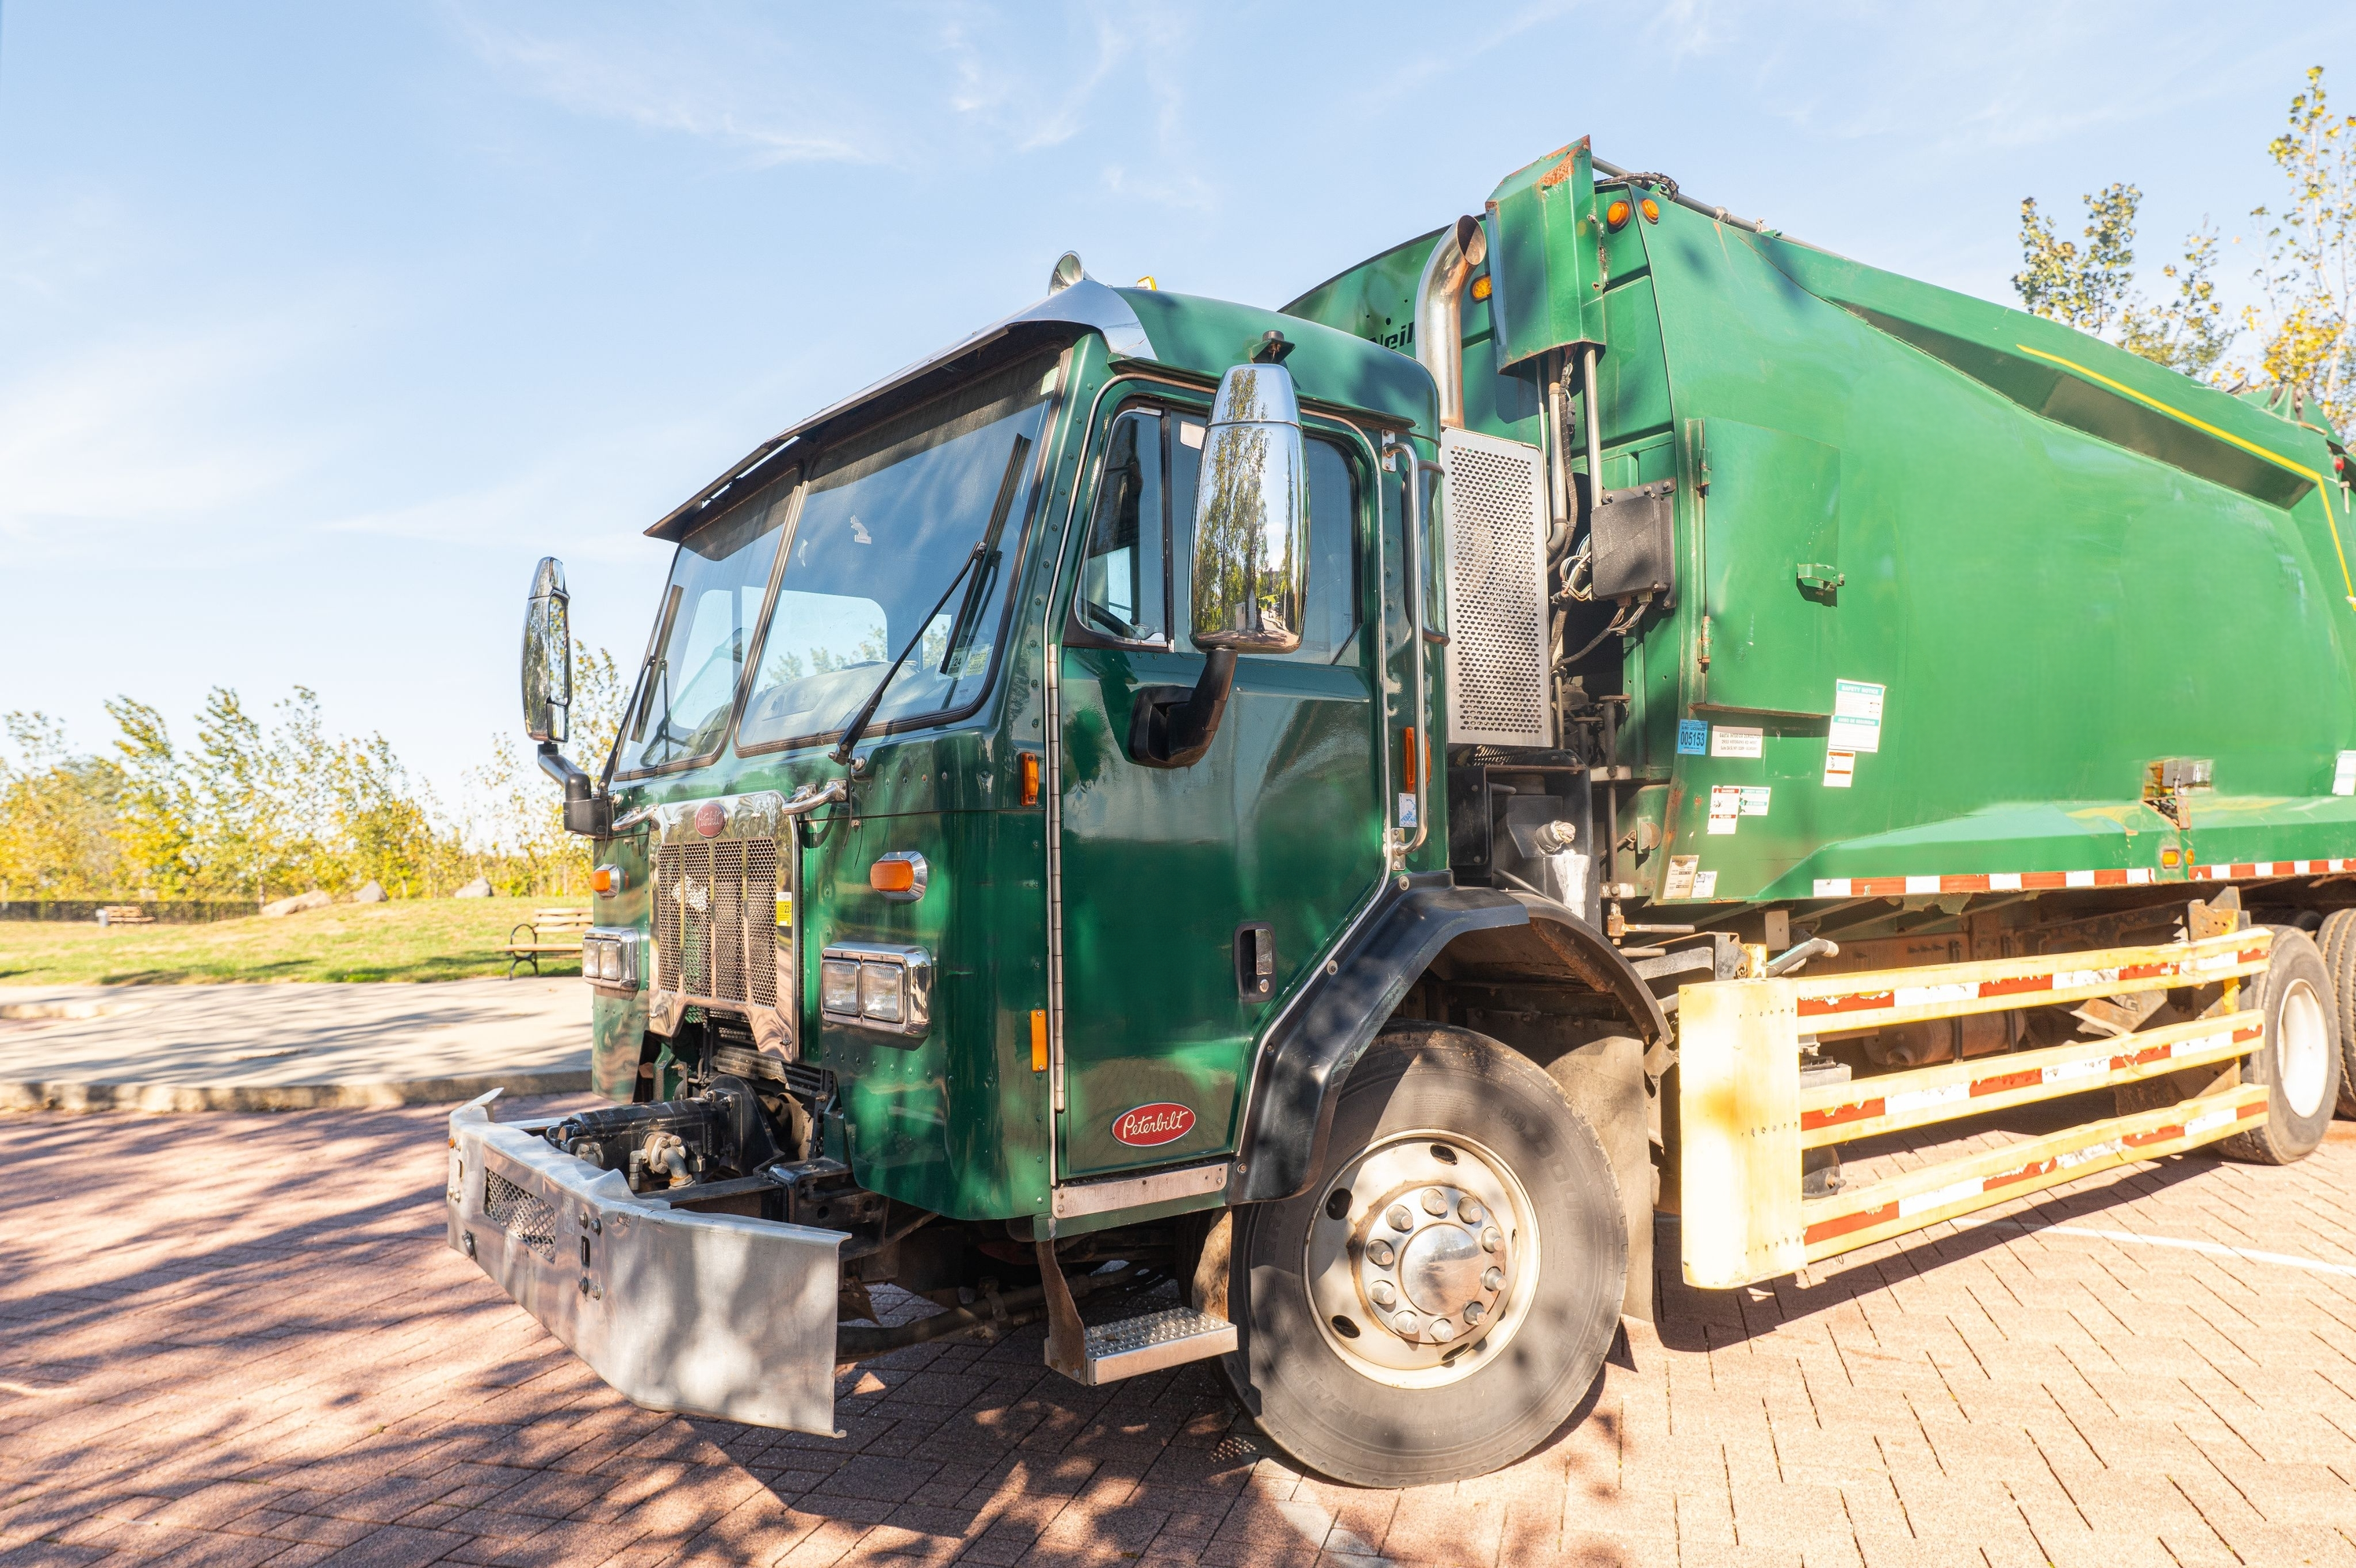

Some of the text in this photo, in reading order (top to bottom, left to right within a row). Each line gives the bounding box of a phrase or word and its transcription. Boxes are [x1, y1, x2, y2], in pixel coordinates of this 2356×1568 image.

[1681, 731, 1705, 747] 005153
[698, 810, 722, 829] Peterbilt
[784, 905, 790, 913] 23
[1123, 1111, 1189, 1139] Peterbilt
